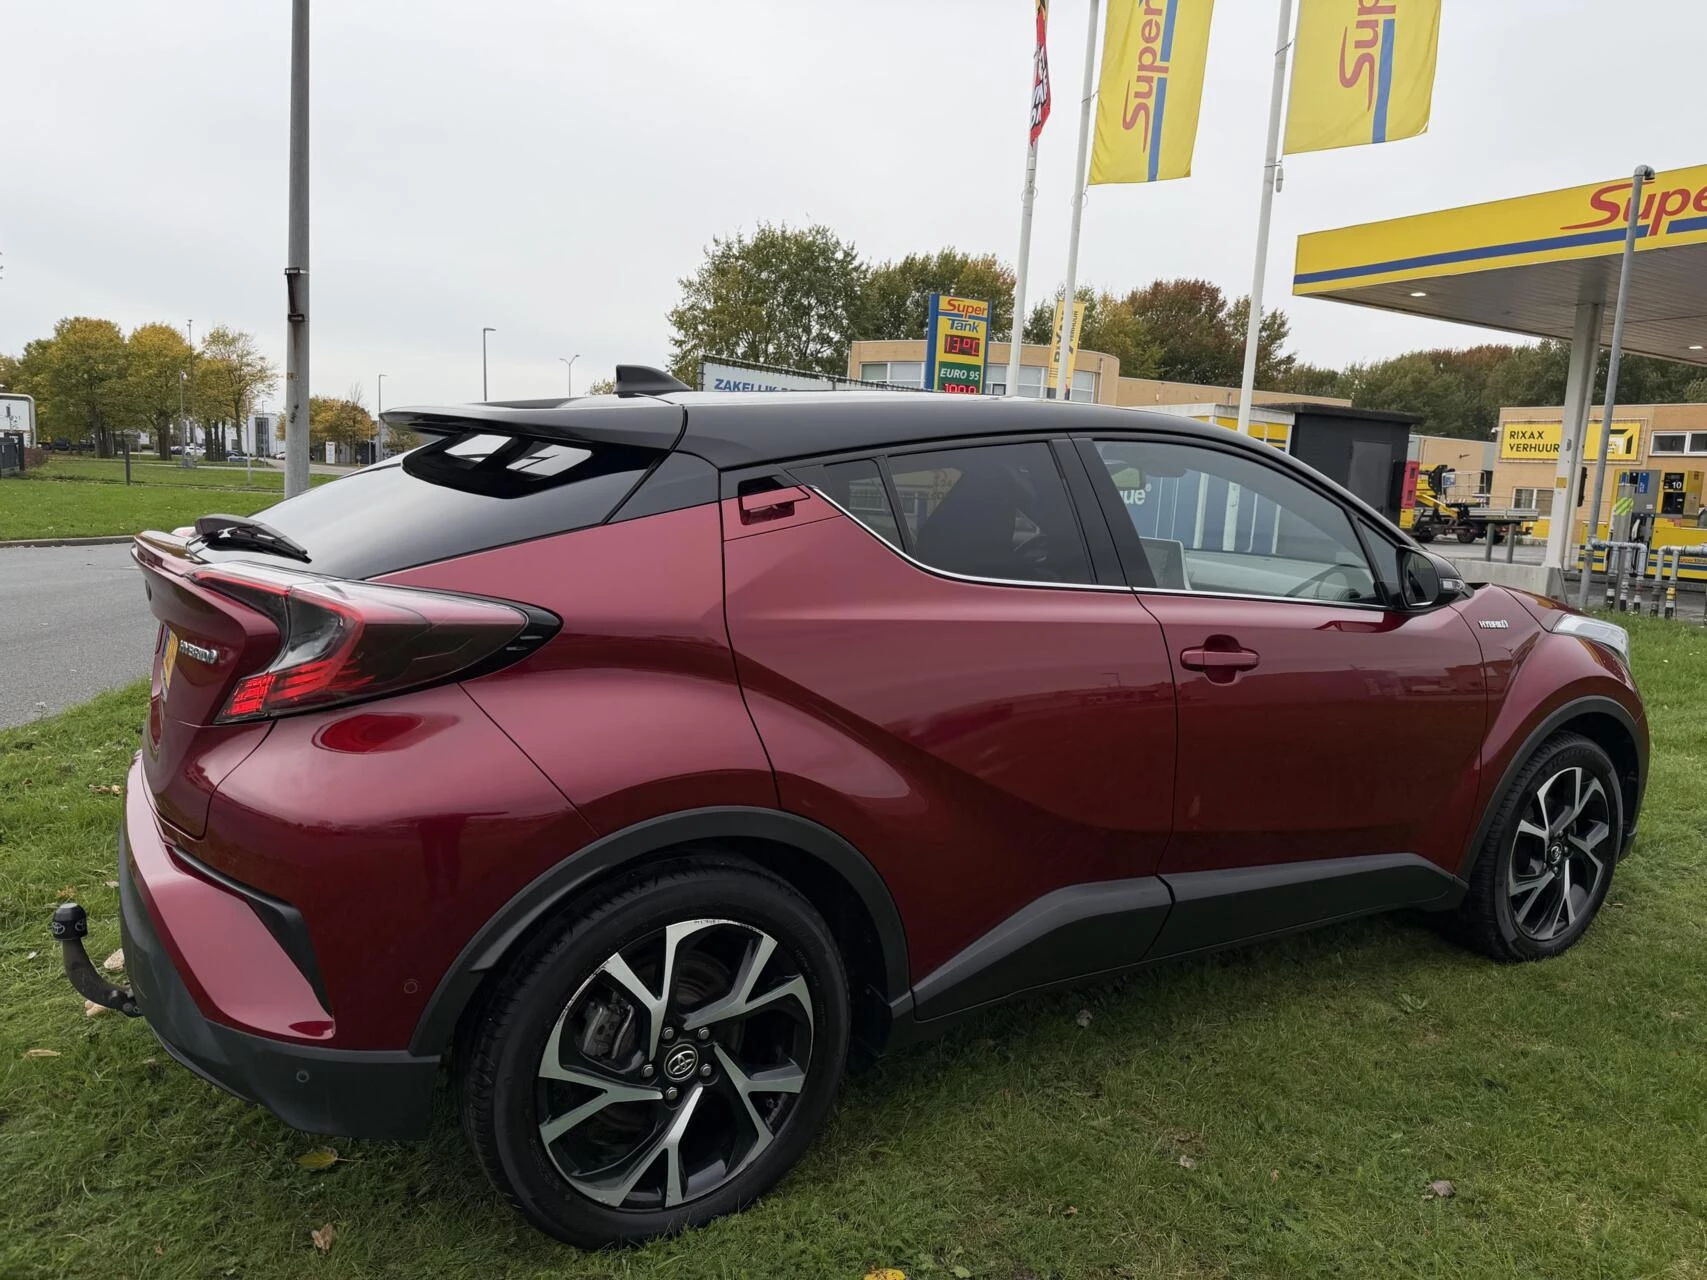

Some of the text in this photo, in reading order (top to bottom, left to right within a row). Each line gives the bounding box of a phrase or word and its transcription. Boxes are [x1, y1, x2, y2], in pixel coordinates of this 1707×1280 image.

[939, 298, 986, 319] Super
[946, 318, 980, 333] Tank
[940, 368, 980, 381] EURO 95
[1509, 430, 1545, 440] RIXAX
[1508, 443, 1560, 453] VERHUUR
[1672, 481, 1682, 489] 10
